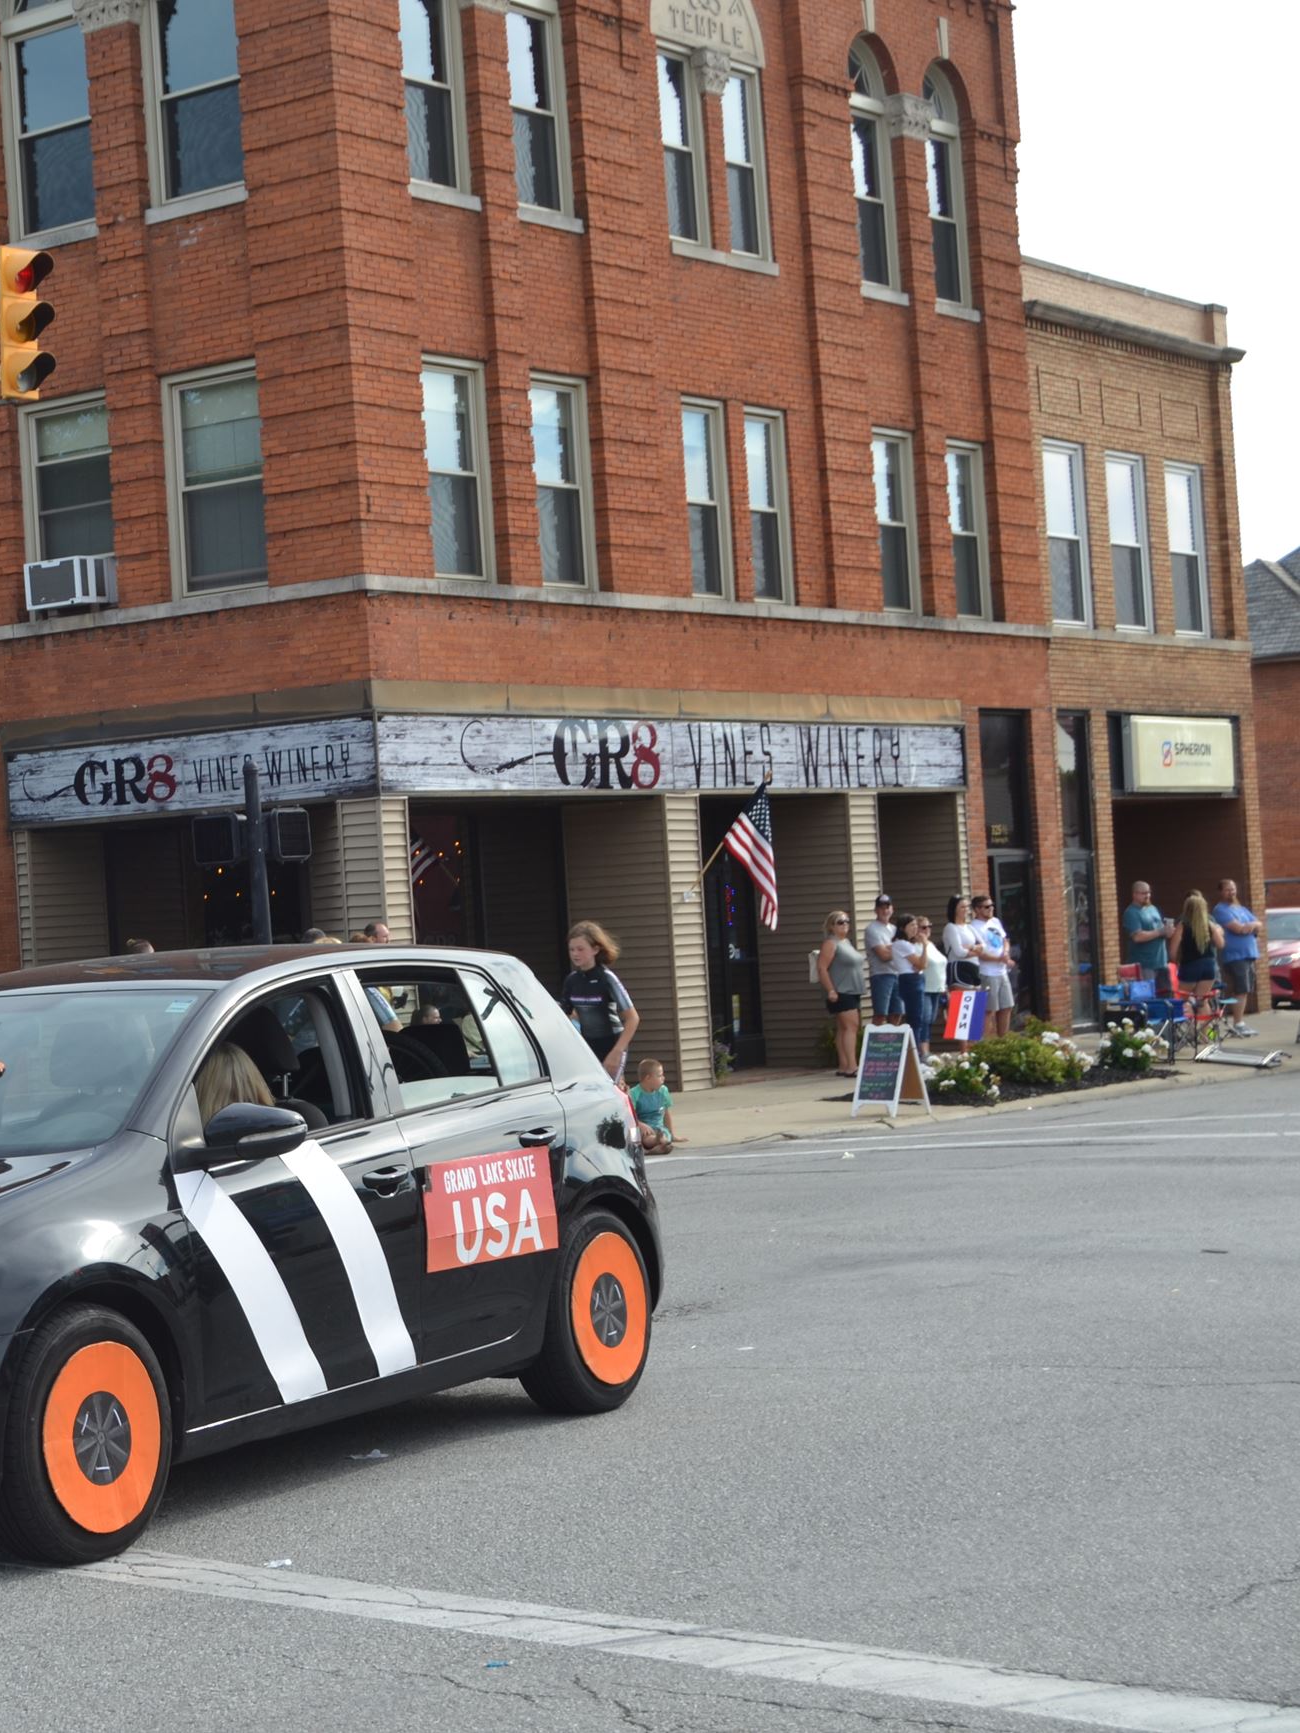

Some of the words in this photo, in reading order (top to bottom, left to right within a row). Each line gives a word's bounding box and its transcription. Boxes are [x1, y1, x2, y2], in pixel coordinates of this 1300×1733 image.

[668, 4, 744, 49] TEMPLE
[73, 753, 177, 806] GR8
[193, 753, 253, 794] VINE
[265, 742, 352, 788] WINERY
[552, 718, 661, 790] GR8
[688, 722, 773, 788] VINES
[798, 726, 903, 788] WINERY
[1174, 742, 1212, 756] SPHERION
[443, 1166, 477, 1194] GRAND
[479, 1160, 505, 1186] LAKE
[505, 1154, 536, 1182] SKATE
[452, 1188, 544, 1265] USA
